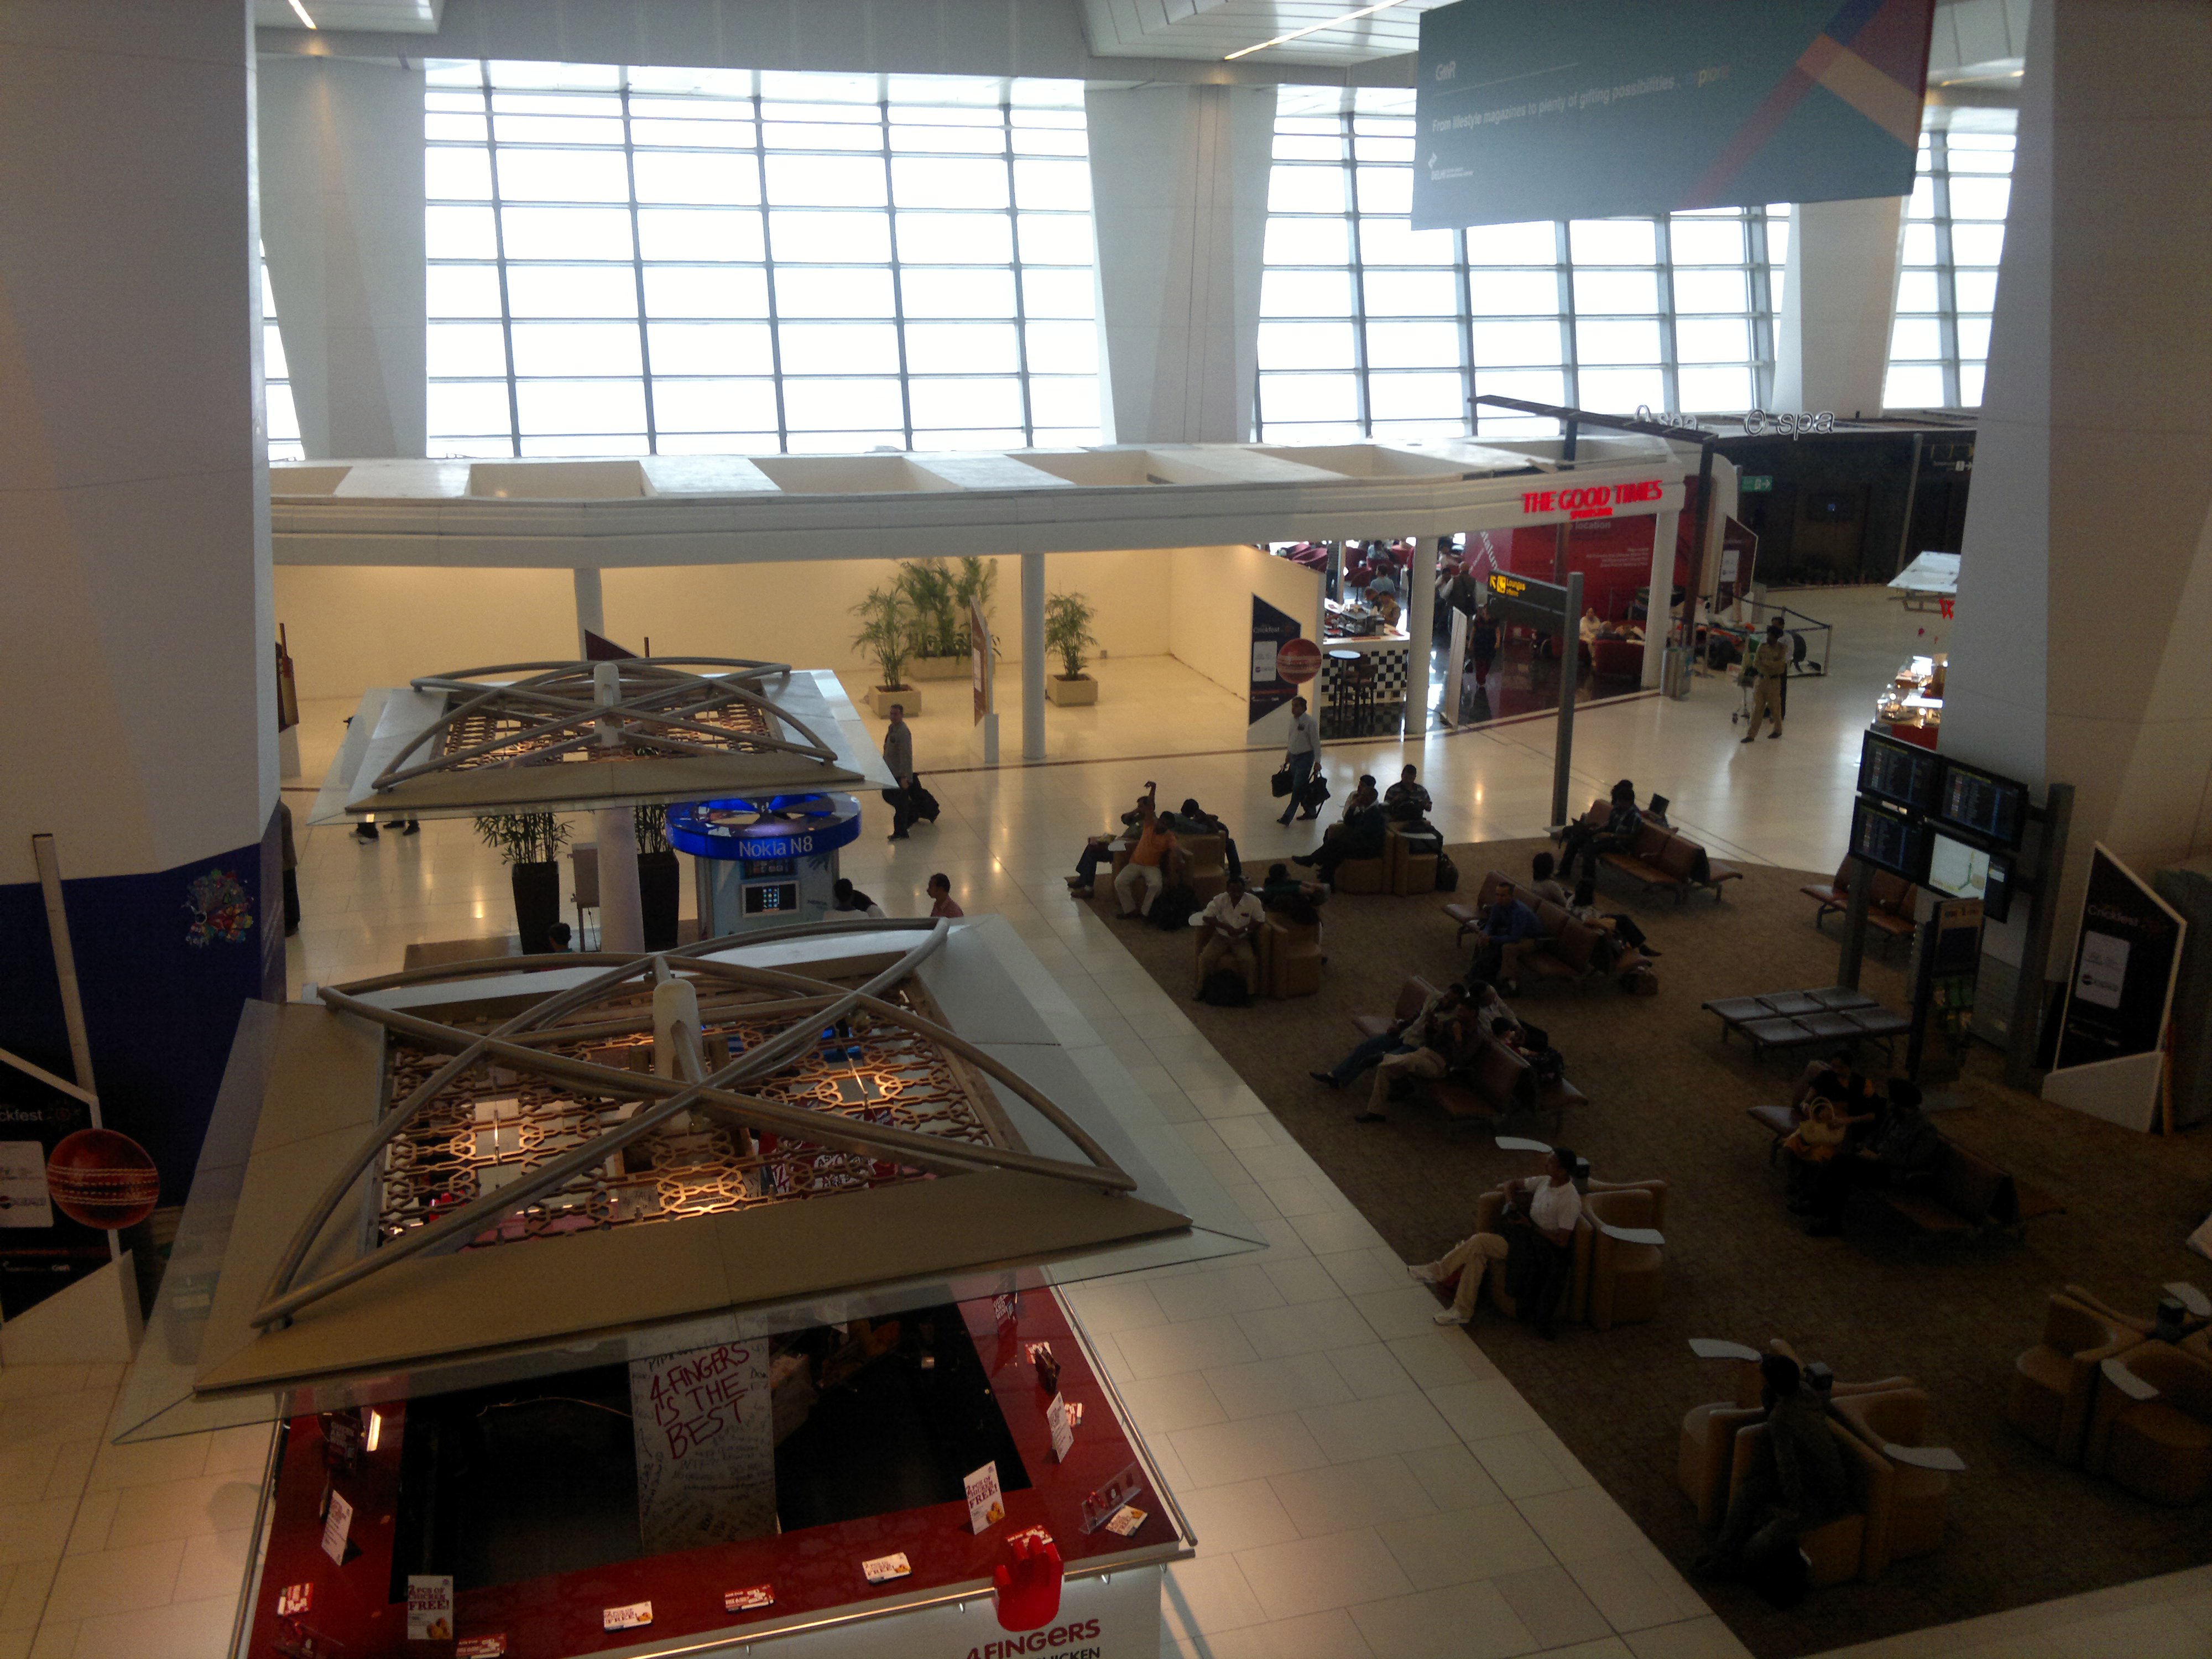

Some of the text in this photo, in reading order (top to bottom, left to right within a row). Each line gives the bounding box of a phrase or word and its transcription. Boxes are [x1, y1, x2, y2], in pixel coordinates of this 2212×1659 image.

[1433, 119, 1451, 132] From
[1453, 112, 1483, 129] lifestyle
[1484, 105, 1526, 125] magazines
[1528, 102, 1537, 116] to
[1539, 96, 1566, 120] plenty
[1568, 92, 1577, 107] of
[1580, 87, 1610, 109] gifting
[1776, 411, 1835, 441] spa
[1521, 491, 1556, 514] THE
[1558, 486, 1610, 511] GOOD
[1613, 479, 1663, 504] TIMES
[1575, 520, 1611, 531] location
[1506, 578, 1526, 592] Lounges
[739, 836, 813, 857] Nokia N8
[655, 1371, 748, 1427] IS THE
[665, 1394, 745, 1460] BEST
[967, 1480, 994, 1499] CHICKEN
[969, 1483, 999, 1509] FREE!
[408, 1594, 446, 1602] CHICKEN
[409, 1599, 450, 1611] FREE!
